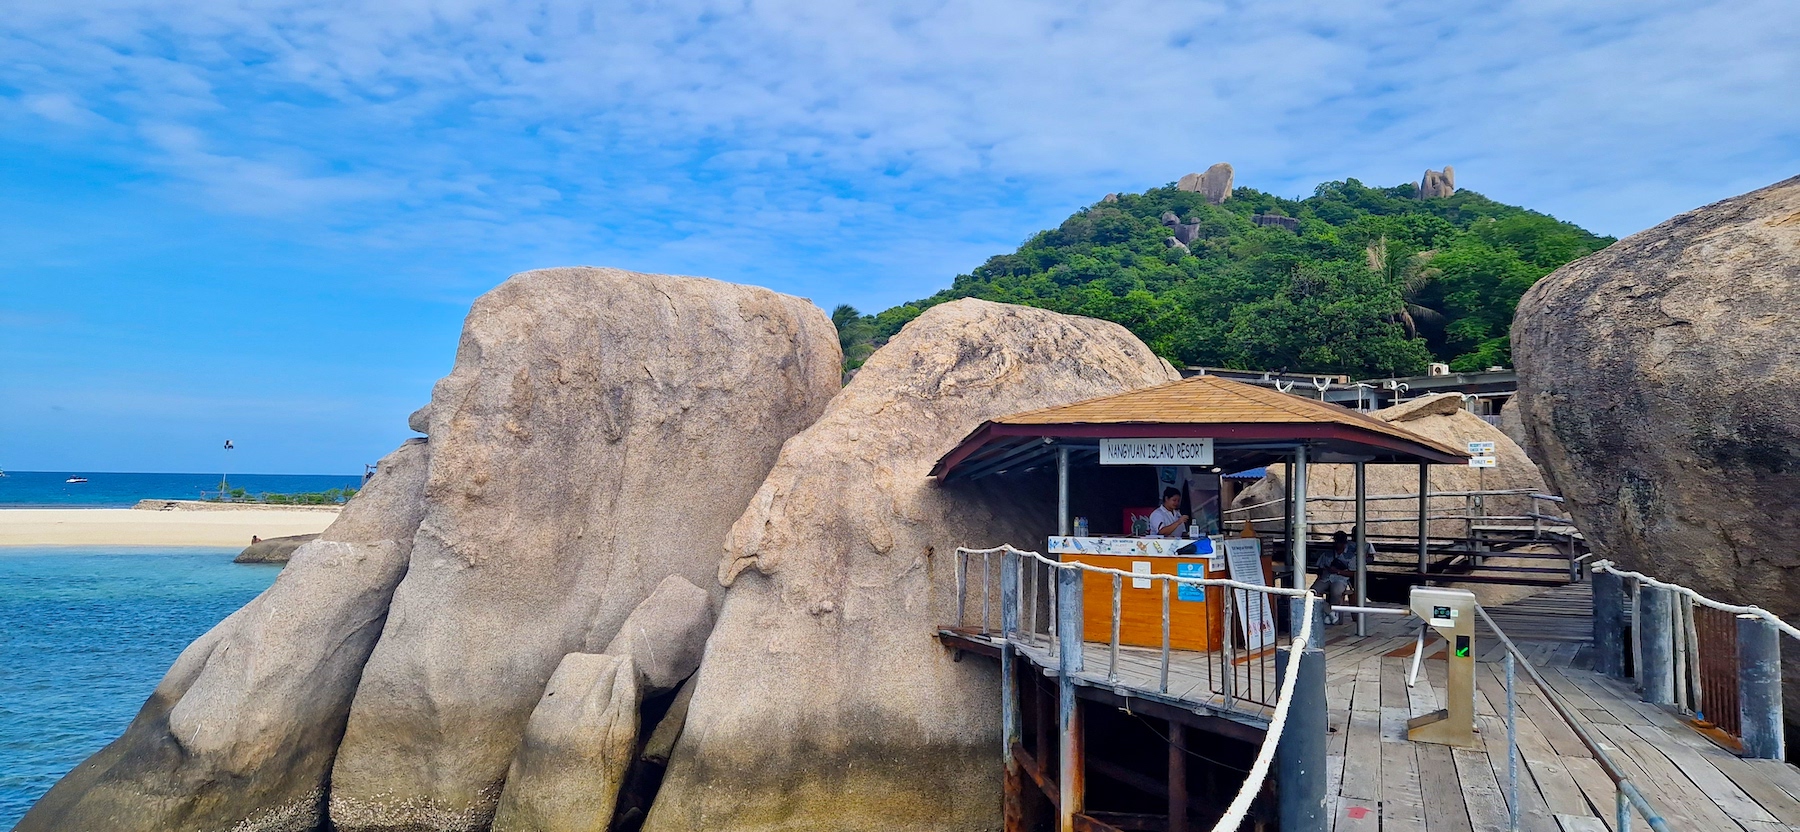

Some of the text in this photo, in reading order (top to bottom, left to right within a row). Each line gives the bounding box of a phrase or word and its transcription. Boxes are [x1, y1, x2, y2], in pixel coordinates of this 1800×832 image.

[1107, 442, 1204, 459] NANGYUAN ISLAND RESORT
